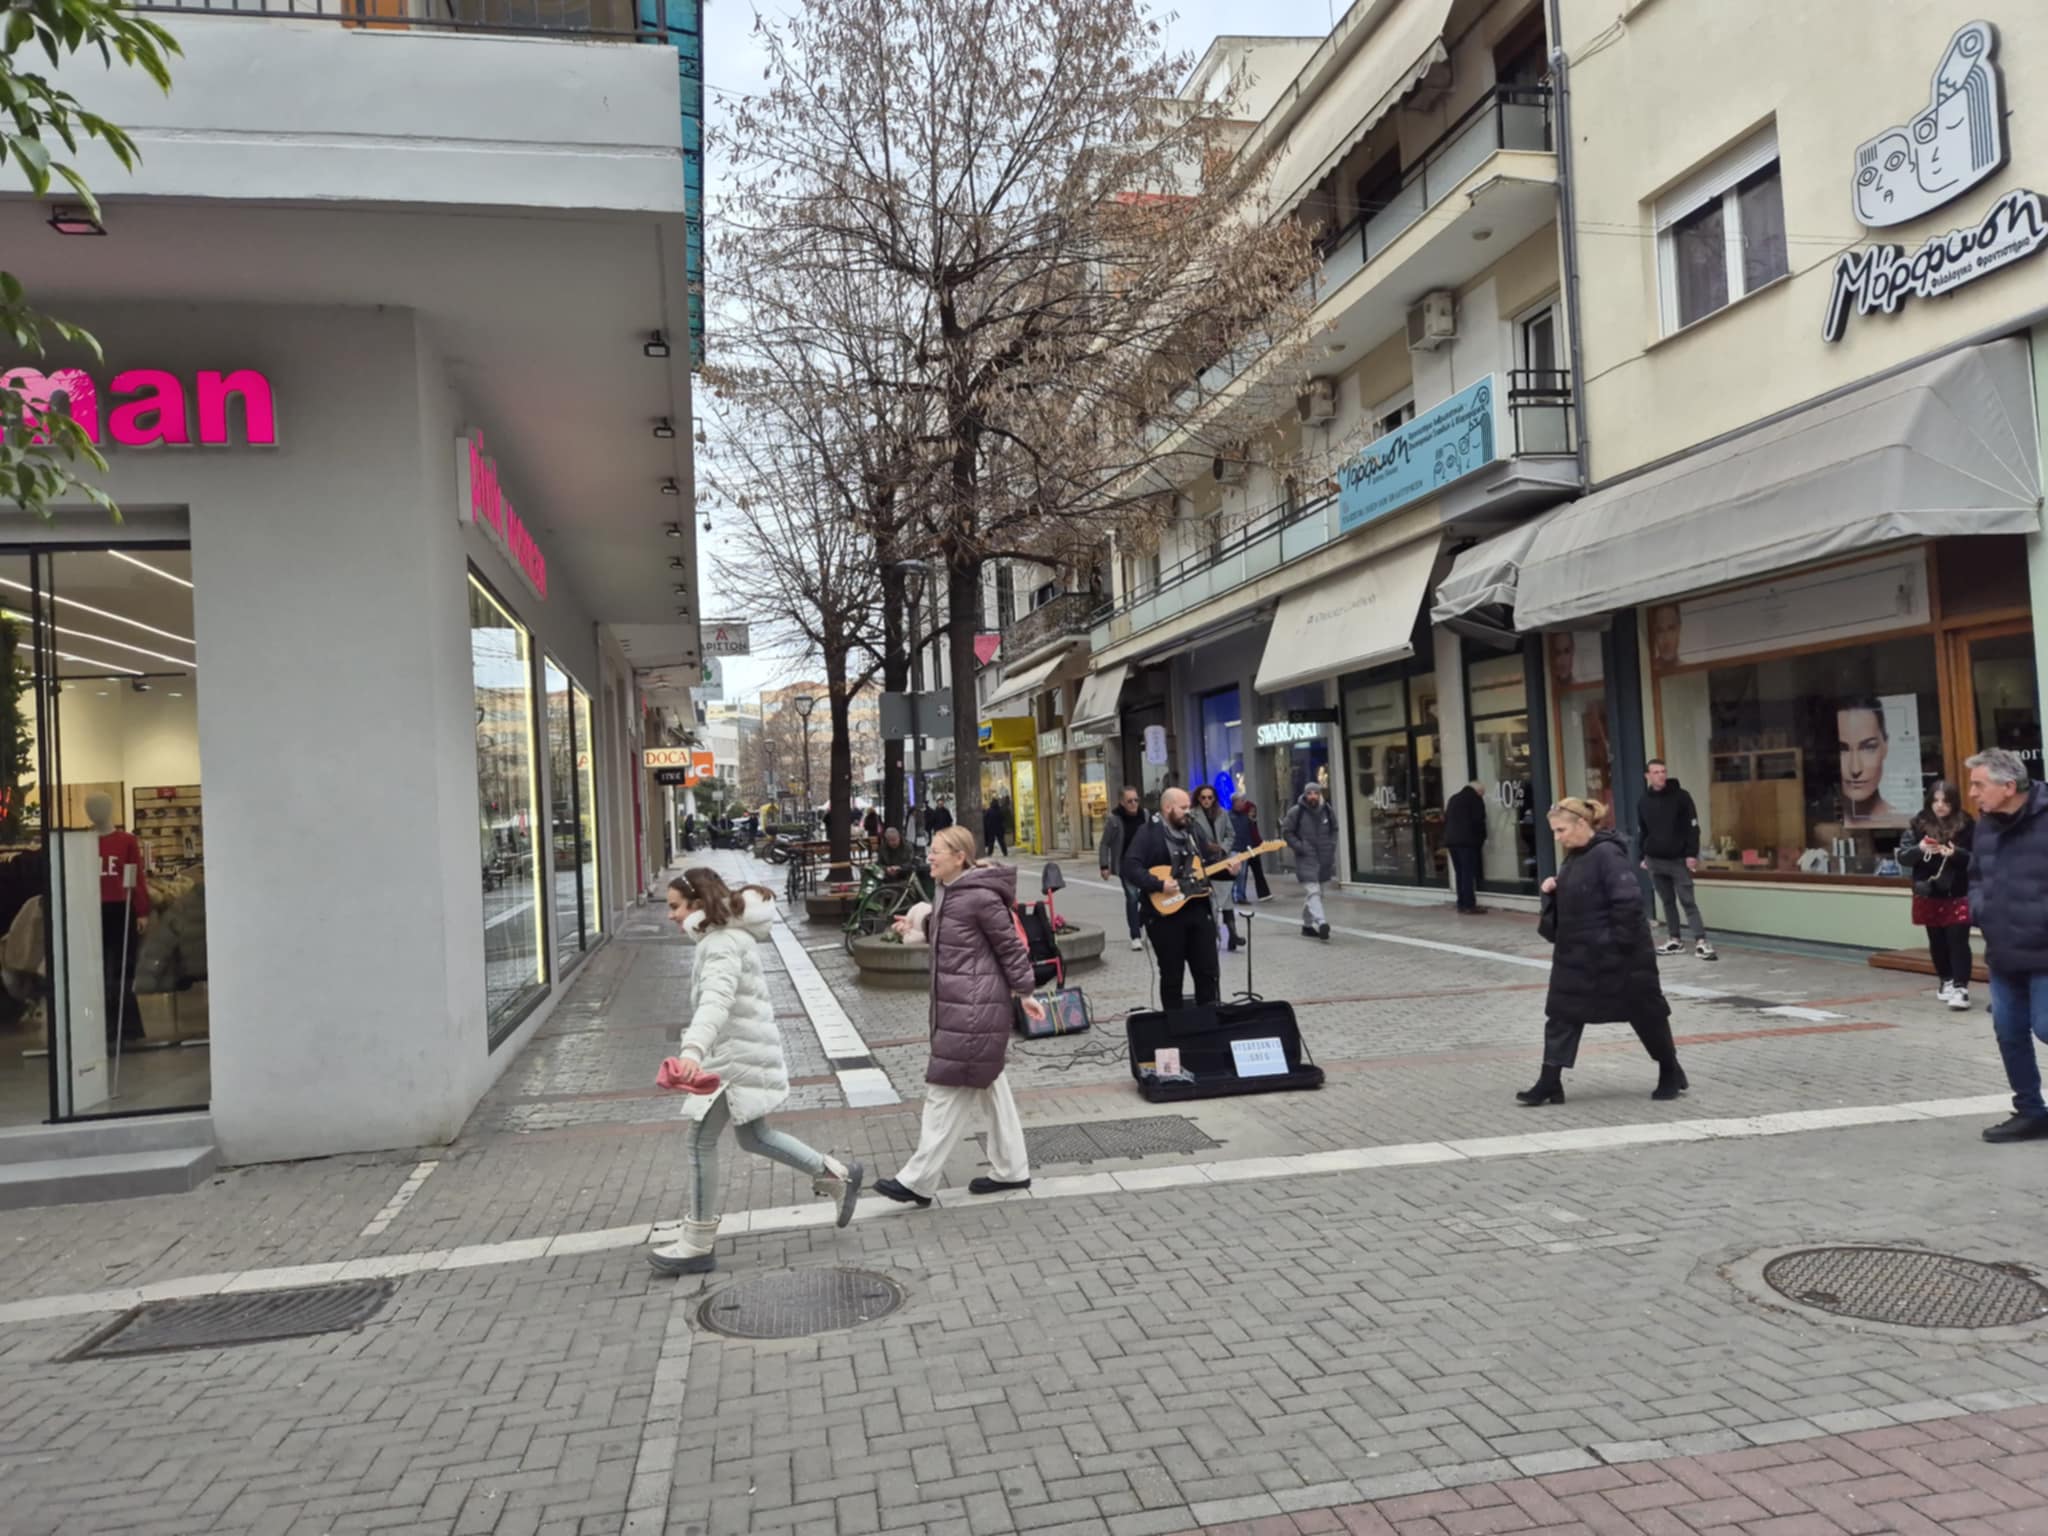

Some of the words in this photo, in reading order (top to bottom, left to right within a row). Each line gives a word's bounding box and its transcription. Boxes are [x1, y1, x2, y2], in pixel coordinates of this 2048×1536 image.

[1826, 195, 2044, 338] Μόρφωση
[1257, 721, 1318, 746] SWAROVSKI
[645, 751, 688, 765] DOCA
